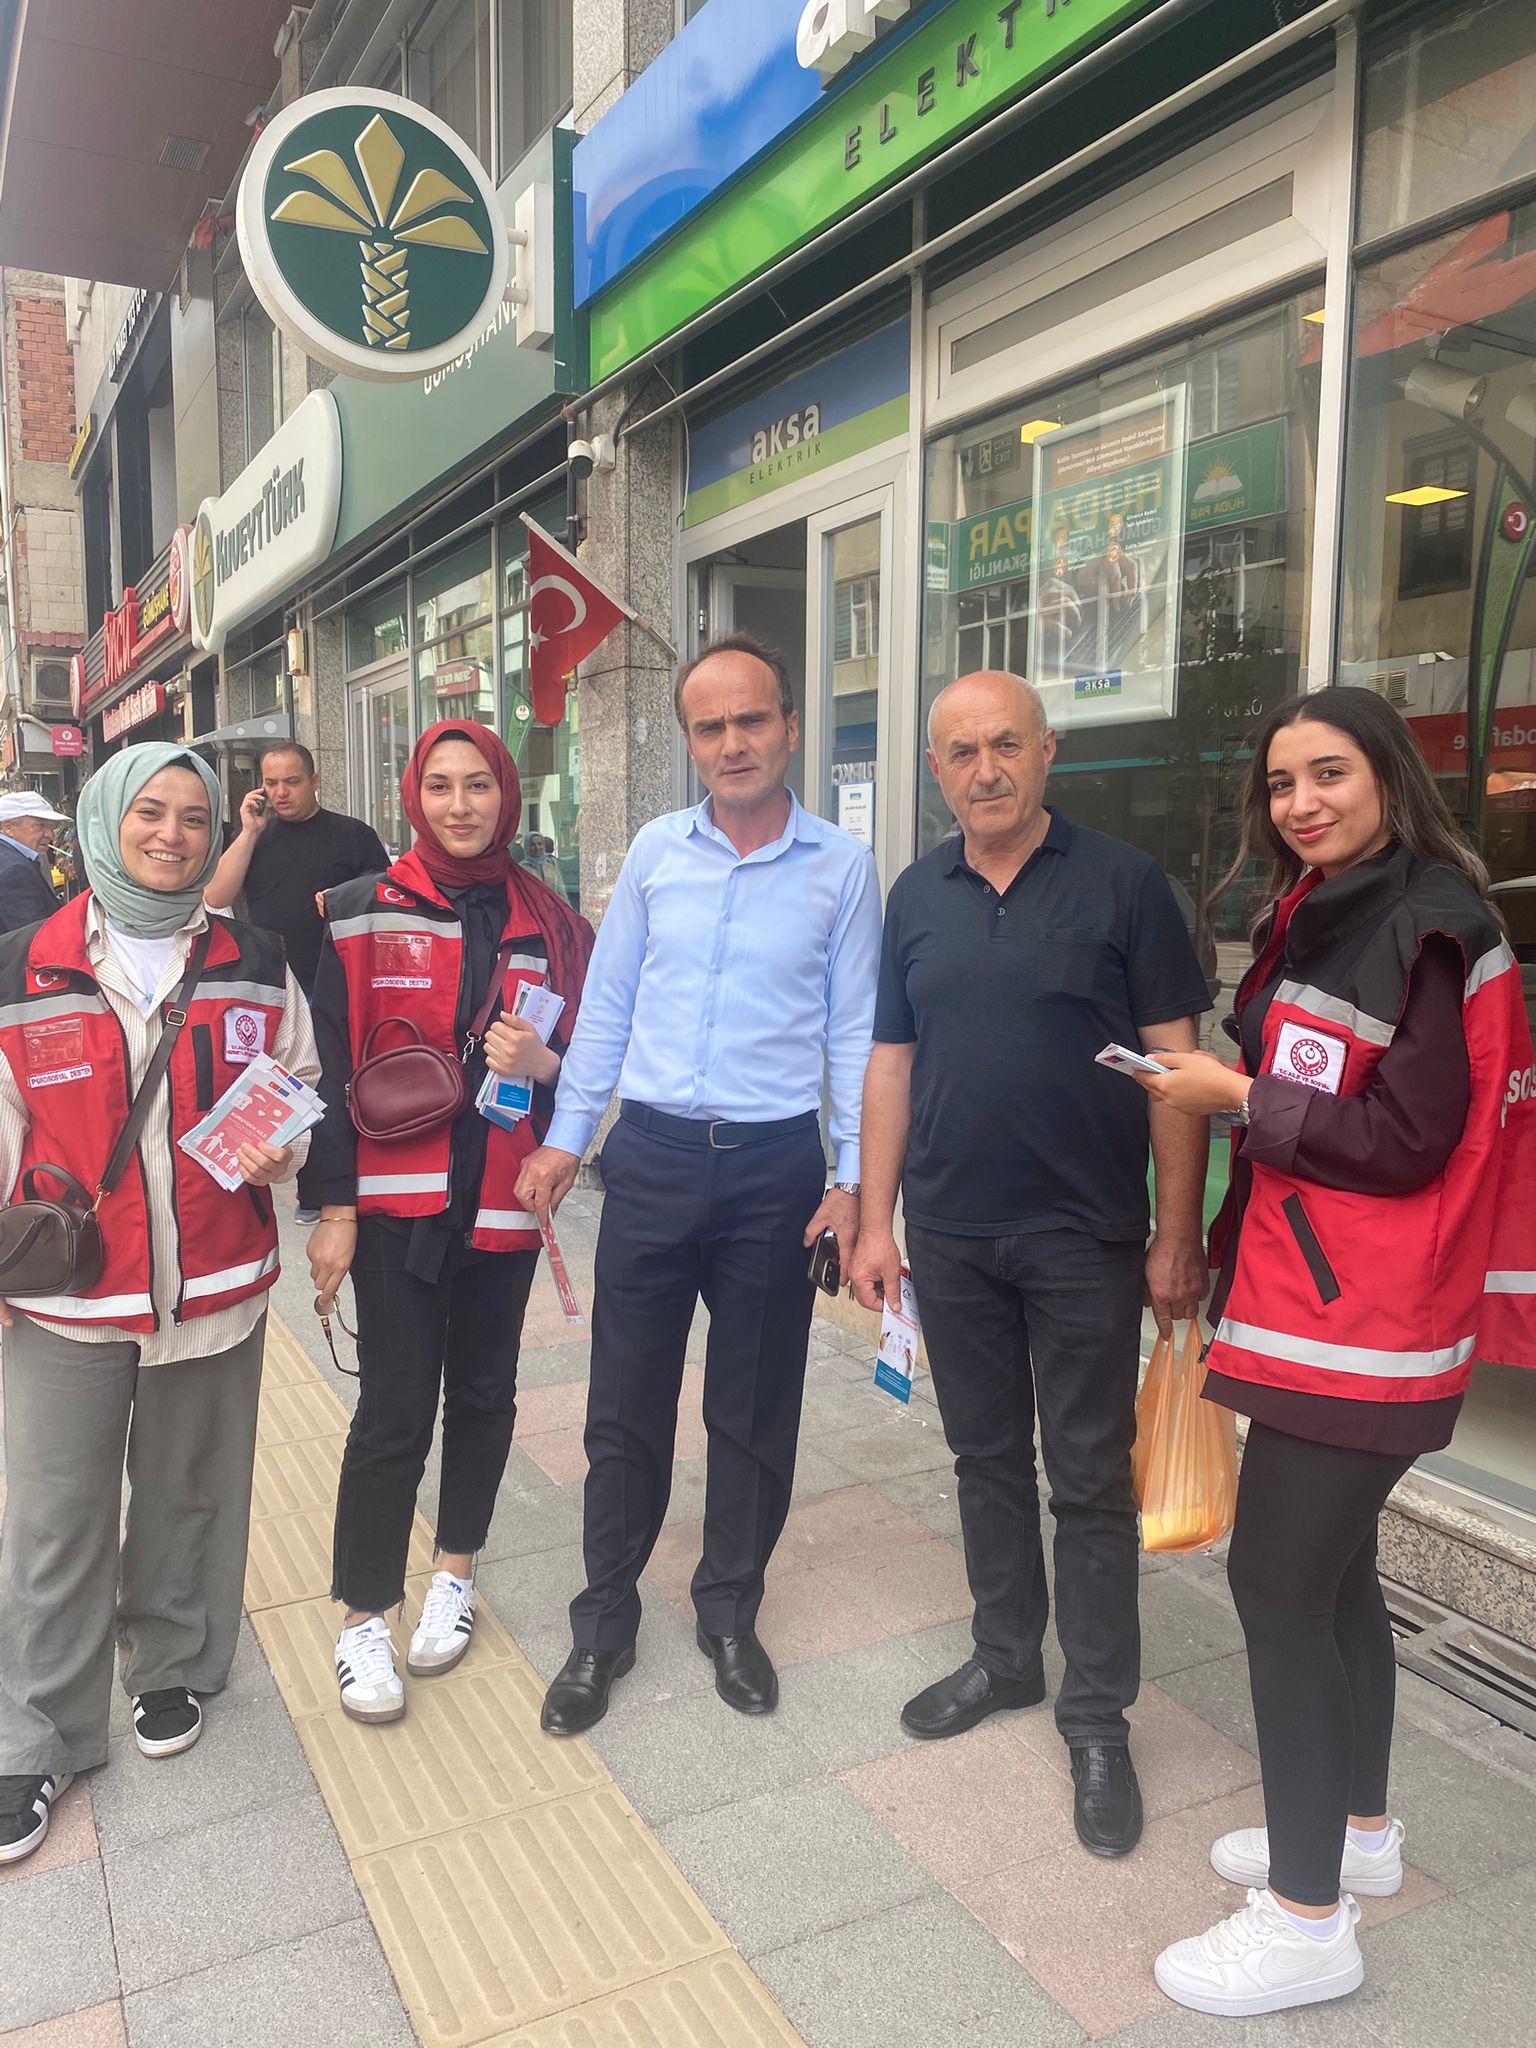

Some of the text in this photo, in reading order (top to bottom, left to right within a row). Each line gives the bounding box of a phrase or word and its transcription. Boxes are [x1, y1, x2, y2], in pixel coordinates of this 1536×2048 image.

[752, 404, 820, 464] aksa
[994, 452, 1011, 467] EXIT
[1084, 678, 1111, 691] aksa
